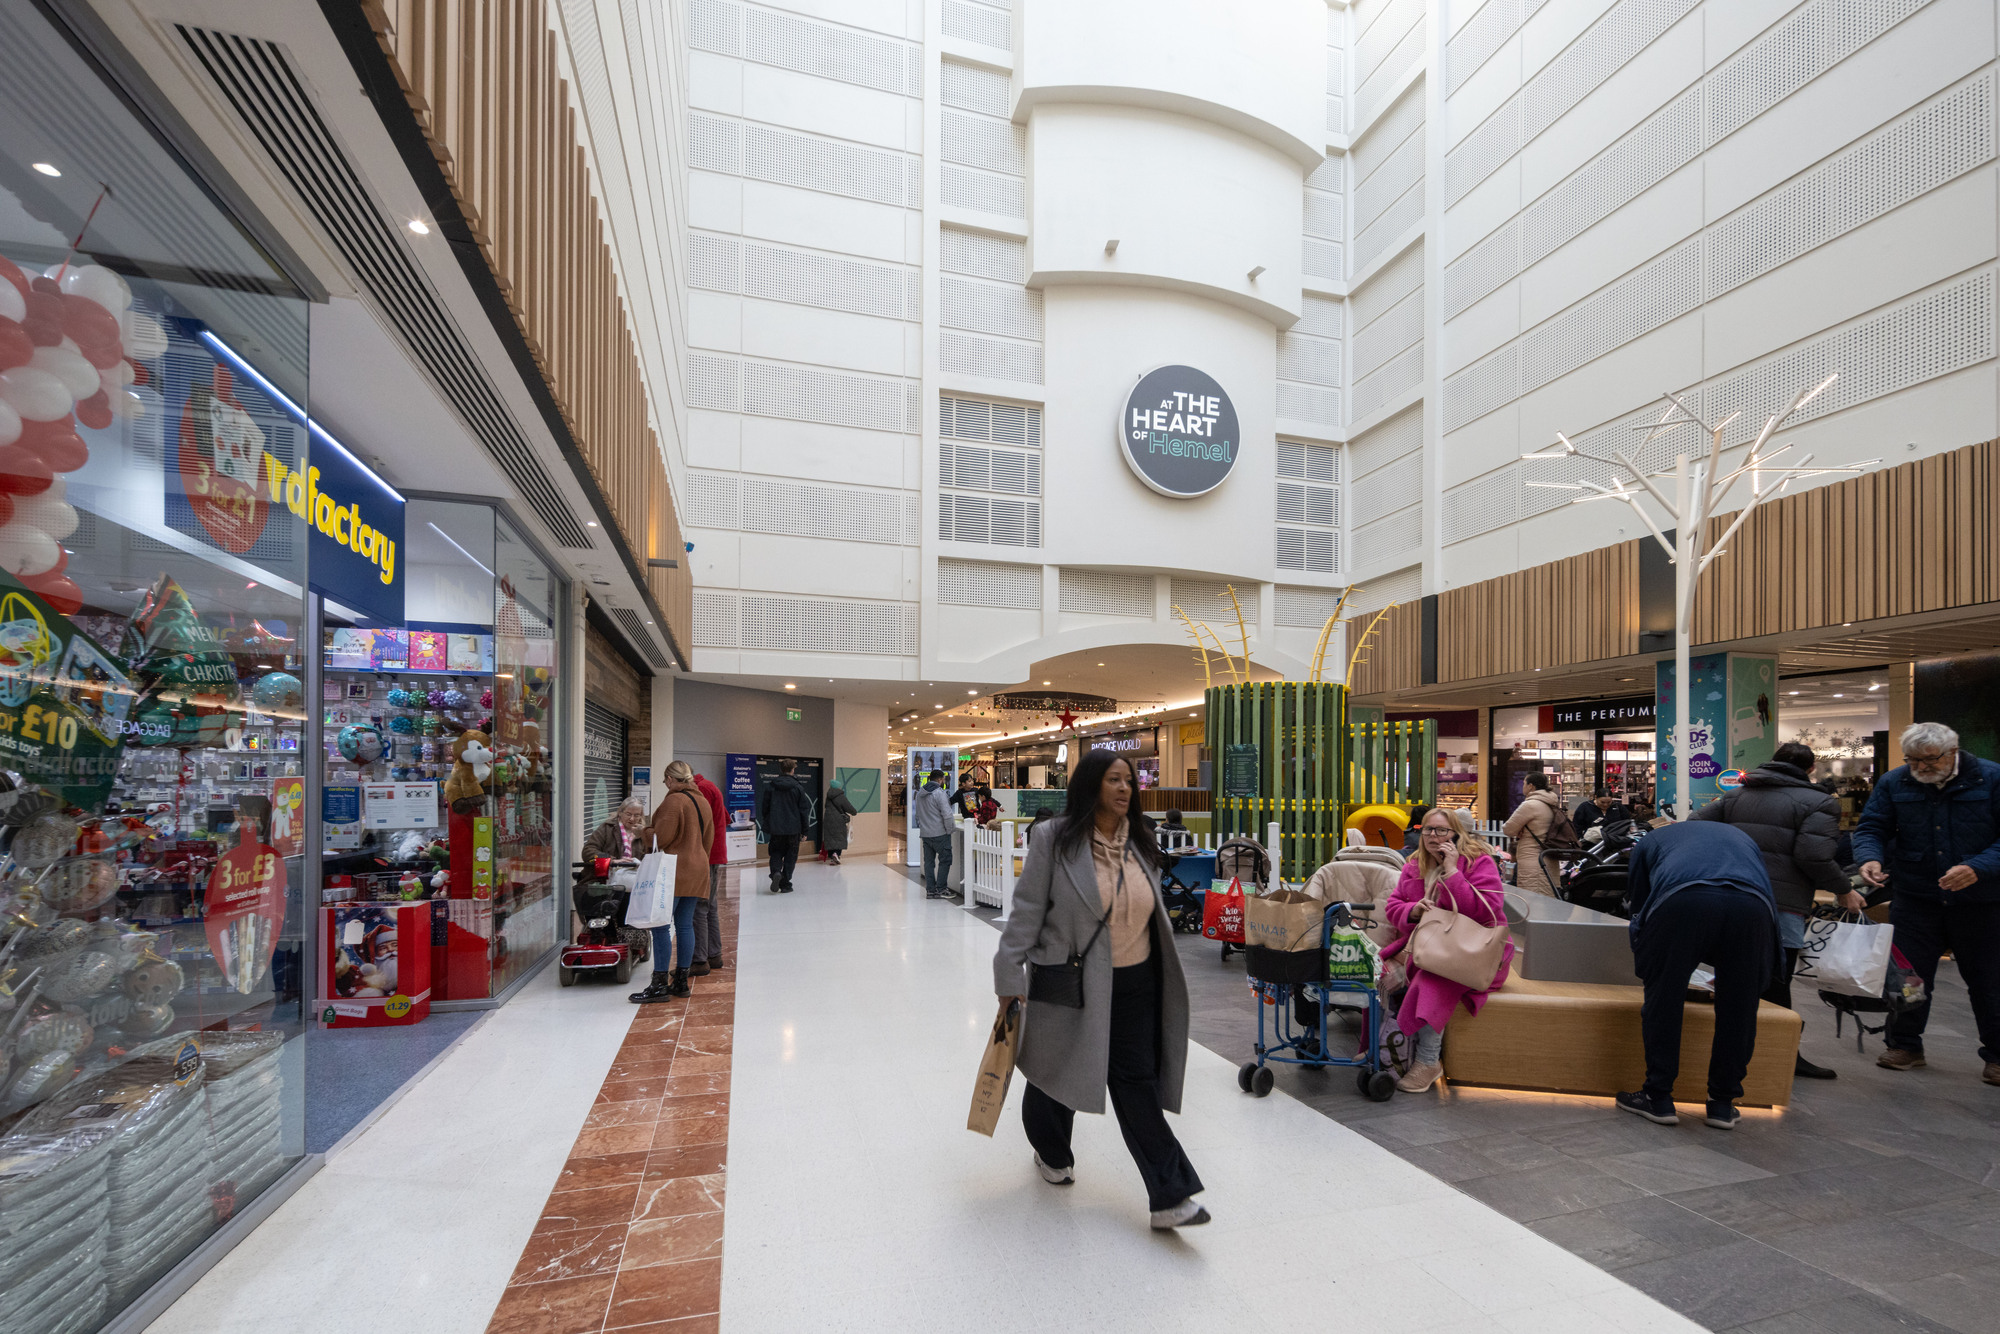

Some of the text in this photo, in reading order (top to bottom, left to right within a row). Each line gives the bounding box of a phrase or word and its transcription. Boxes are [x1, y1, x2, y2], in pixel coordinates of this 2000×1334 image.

[1160, 391, 1220, 416] AT THE
[1132, 408, 1217, 437] HEART
[1132, 430, 1231, 463] OF Hemel
[195, 461, 210, 494] 3
[212, 482, 230, 508] for
[232, 487, 256, 524] £1
[263, 449, 396, 585] rdfactory
[0, 712, 18, 732] or
[20, 704, 78, 750] £10
[1557, 711, 1582, 723] THE
[1117, 738, 1142, 751] WORLD
[1689, 740, 1708, 751] CLUB
[1690, 760, 1711, 768] JOIN
[219, 853, 275, 889] 3 for £3
[225, 886, 270, 902] selected roll wrap
[1248, 921, 1288, 936] RIMAR
[1795, 920, 1838, 979] M&S
[1329, 963, 1369, 974] wards
[387, 1002, 409, 1011] £1.29
